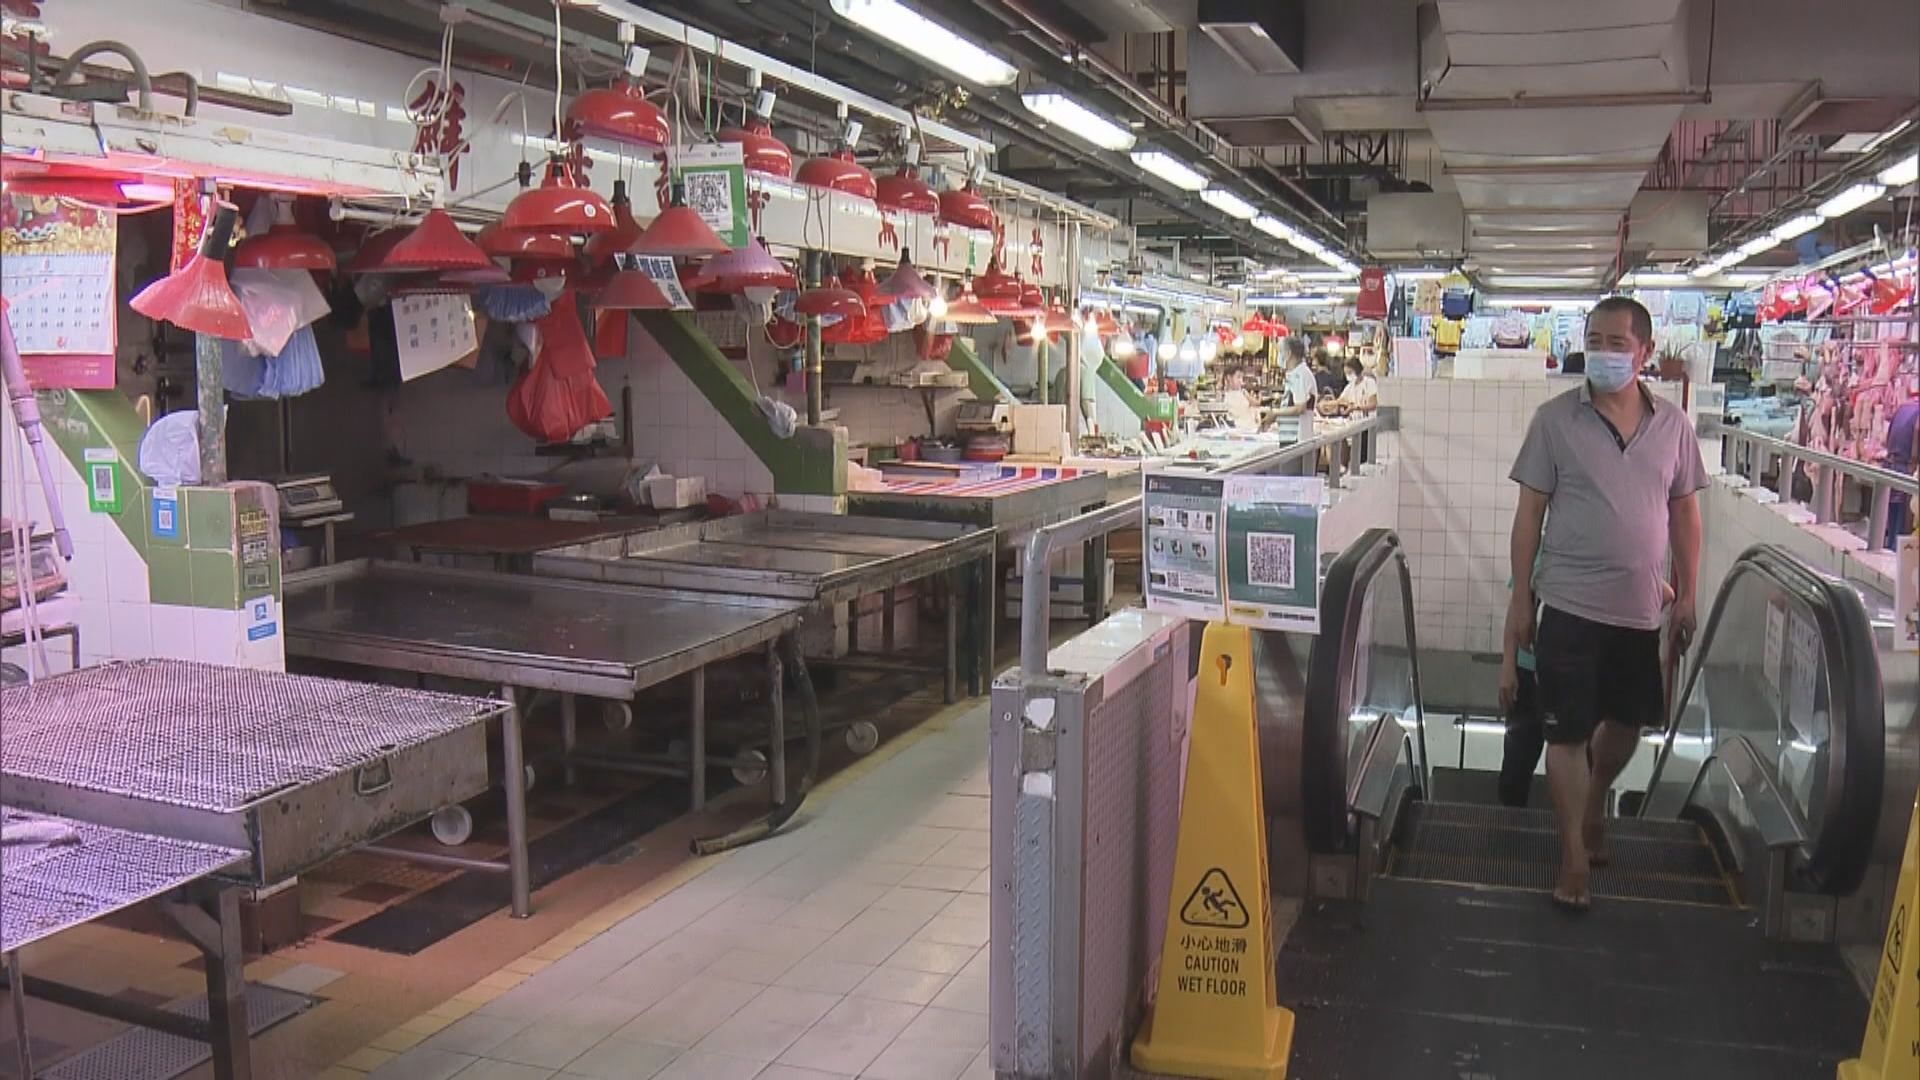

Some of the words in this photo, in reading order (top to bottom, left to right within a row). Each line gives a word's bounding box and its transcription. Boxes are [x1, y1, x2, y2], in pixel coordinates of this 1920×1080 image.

[1181, 933, 1248, 954] 小心地滑
[1185, 954, 1239, 973] CAUTION
[1178, 976, 1202, 993] WET
[1206, 978, 1246, 996] FLOOR
